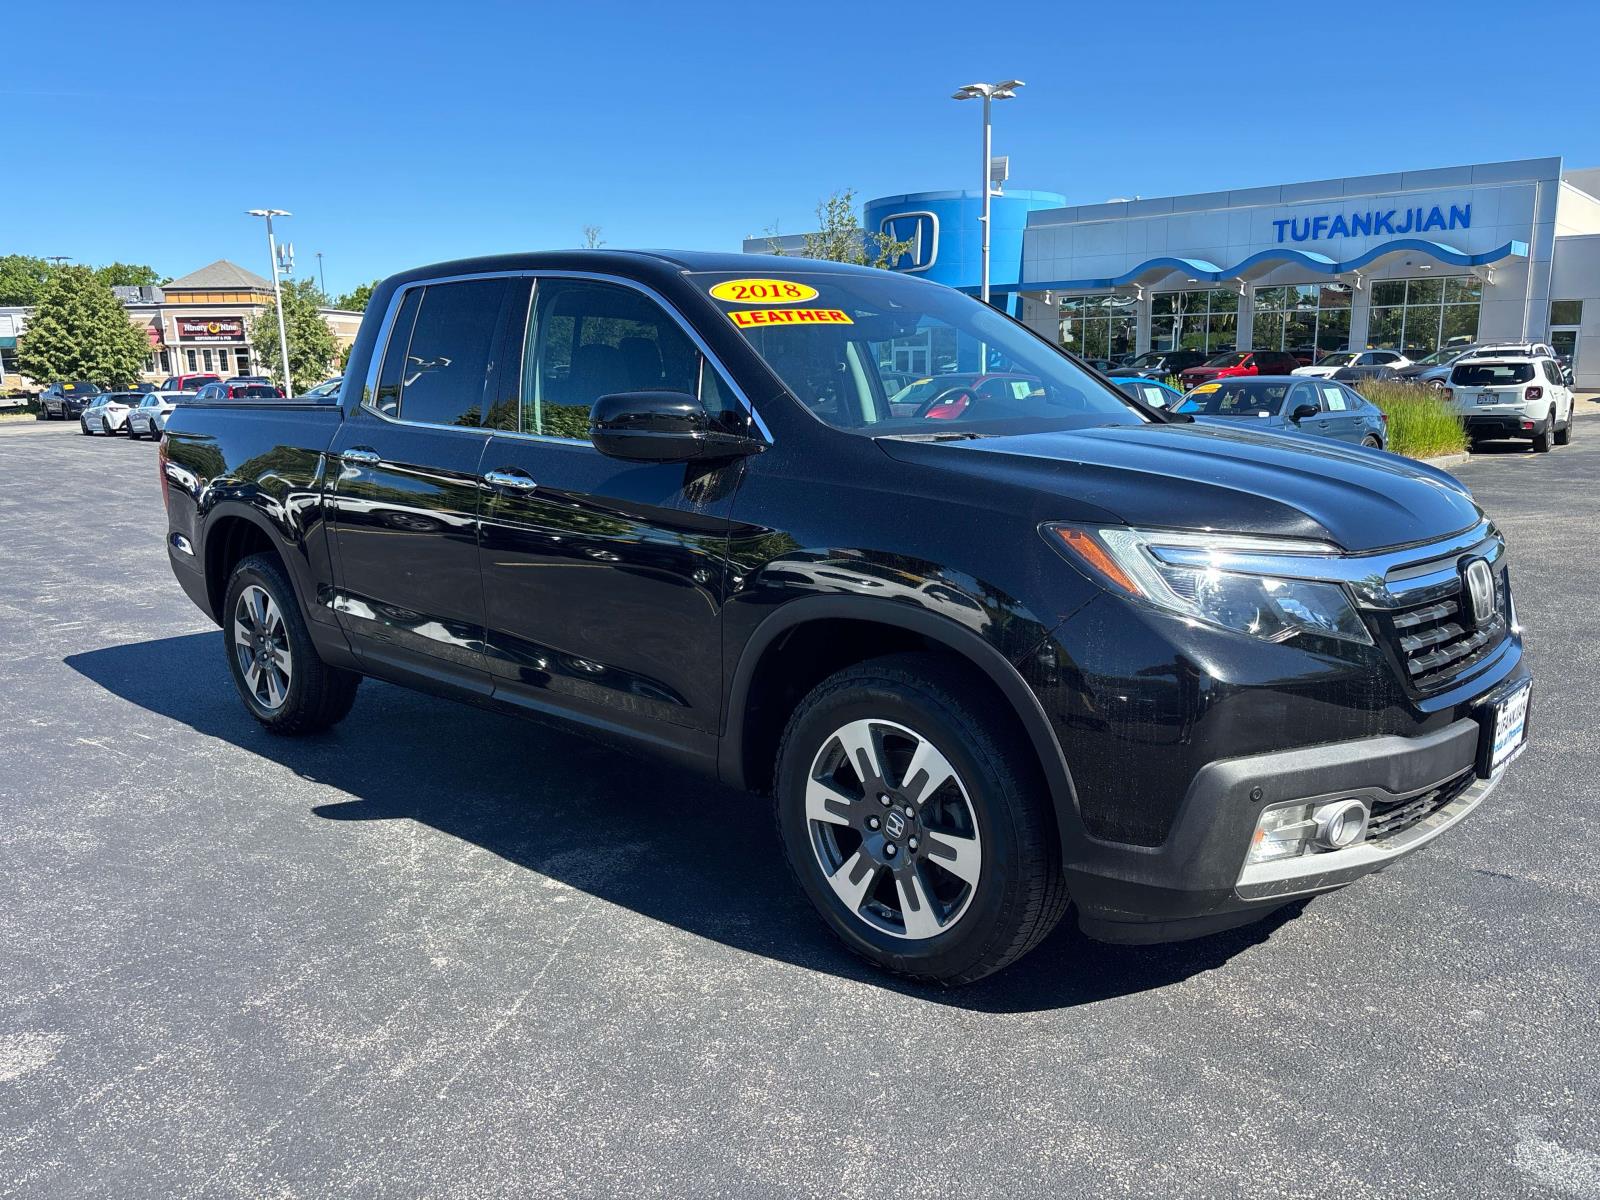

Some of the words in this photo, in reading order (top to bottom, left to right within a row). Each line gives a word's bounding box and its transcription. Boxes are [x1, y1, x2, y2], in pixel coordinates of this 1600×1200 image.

[1273, 204, 1471, 243] TUFANKJIAN
[731, 283, 802, 300] 2018
[735, 310, 850, 325] LEATHER
[184, 324, 208, 332] Ninety
